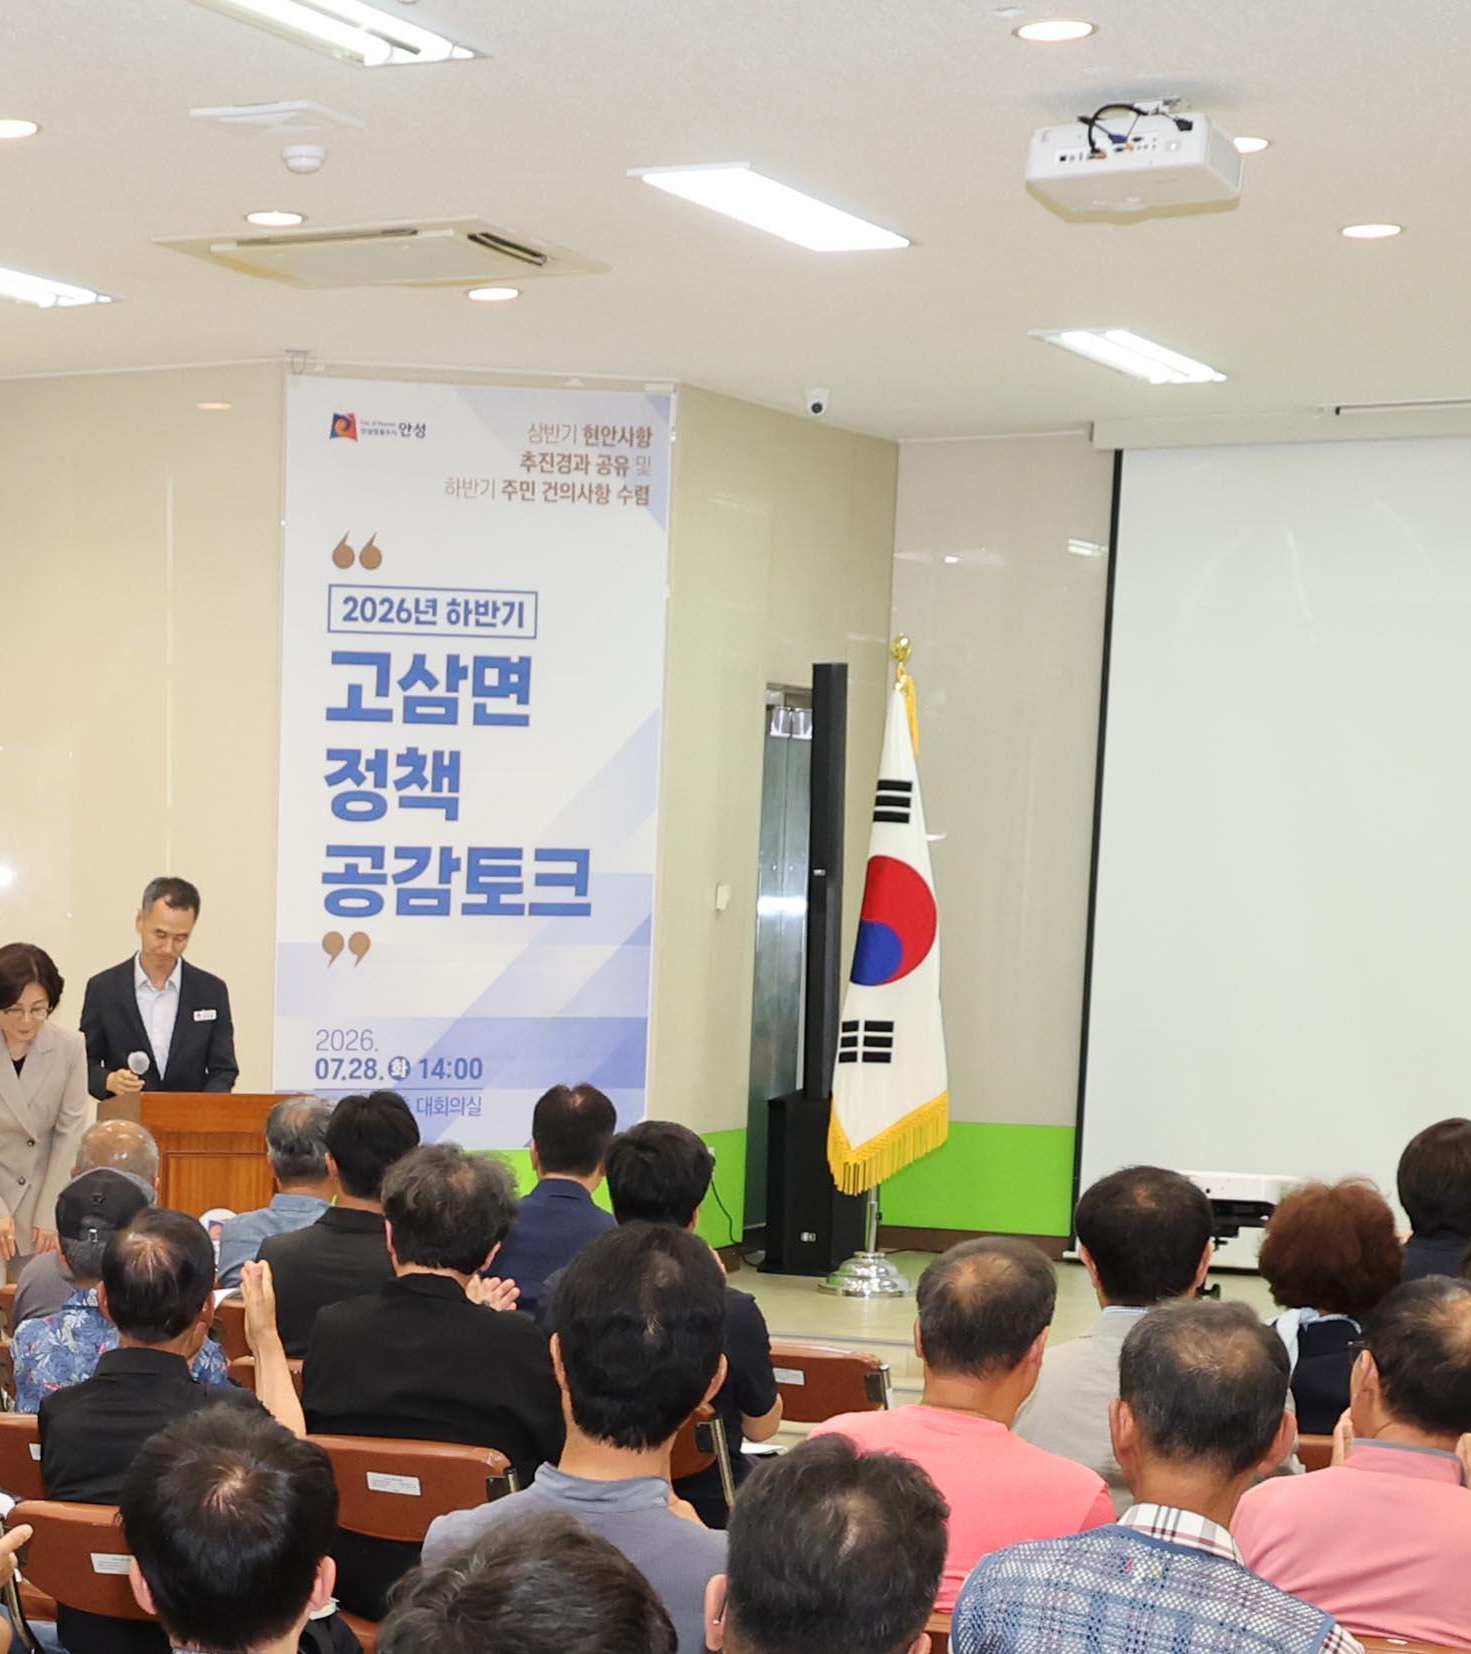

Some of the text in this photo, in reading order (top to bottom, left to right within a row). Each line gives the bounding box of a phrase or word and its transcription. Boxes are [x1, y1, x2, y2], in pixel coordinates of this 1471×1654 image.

[398, 421, 427, 439] 안성
[527, 423, 653, 449] 상반기 현안사항
[519, 451, 652, 477] 추진경과 공유 및
[444, 476, 650, 506] 하반기 주민 건의사항 수렴
[342, 595, 525, 629] 2026년 하반기
[325, 650, 532, 727] 고삼면
[323, 746, 461, 823] 정책
[321, 843, 592, 918] 공감토크
[315, 1028, 380, 1052] 2026.
[315, 1057, 385, 1081] 07.28.
[419, 1056, 483, 1080] 14:00
[416, 1095, 483, 1117] 대회의실
